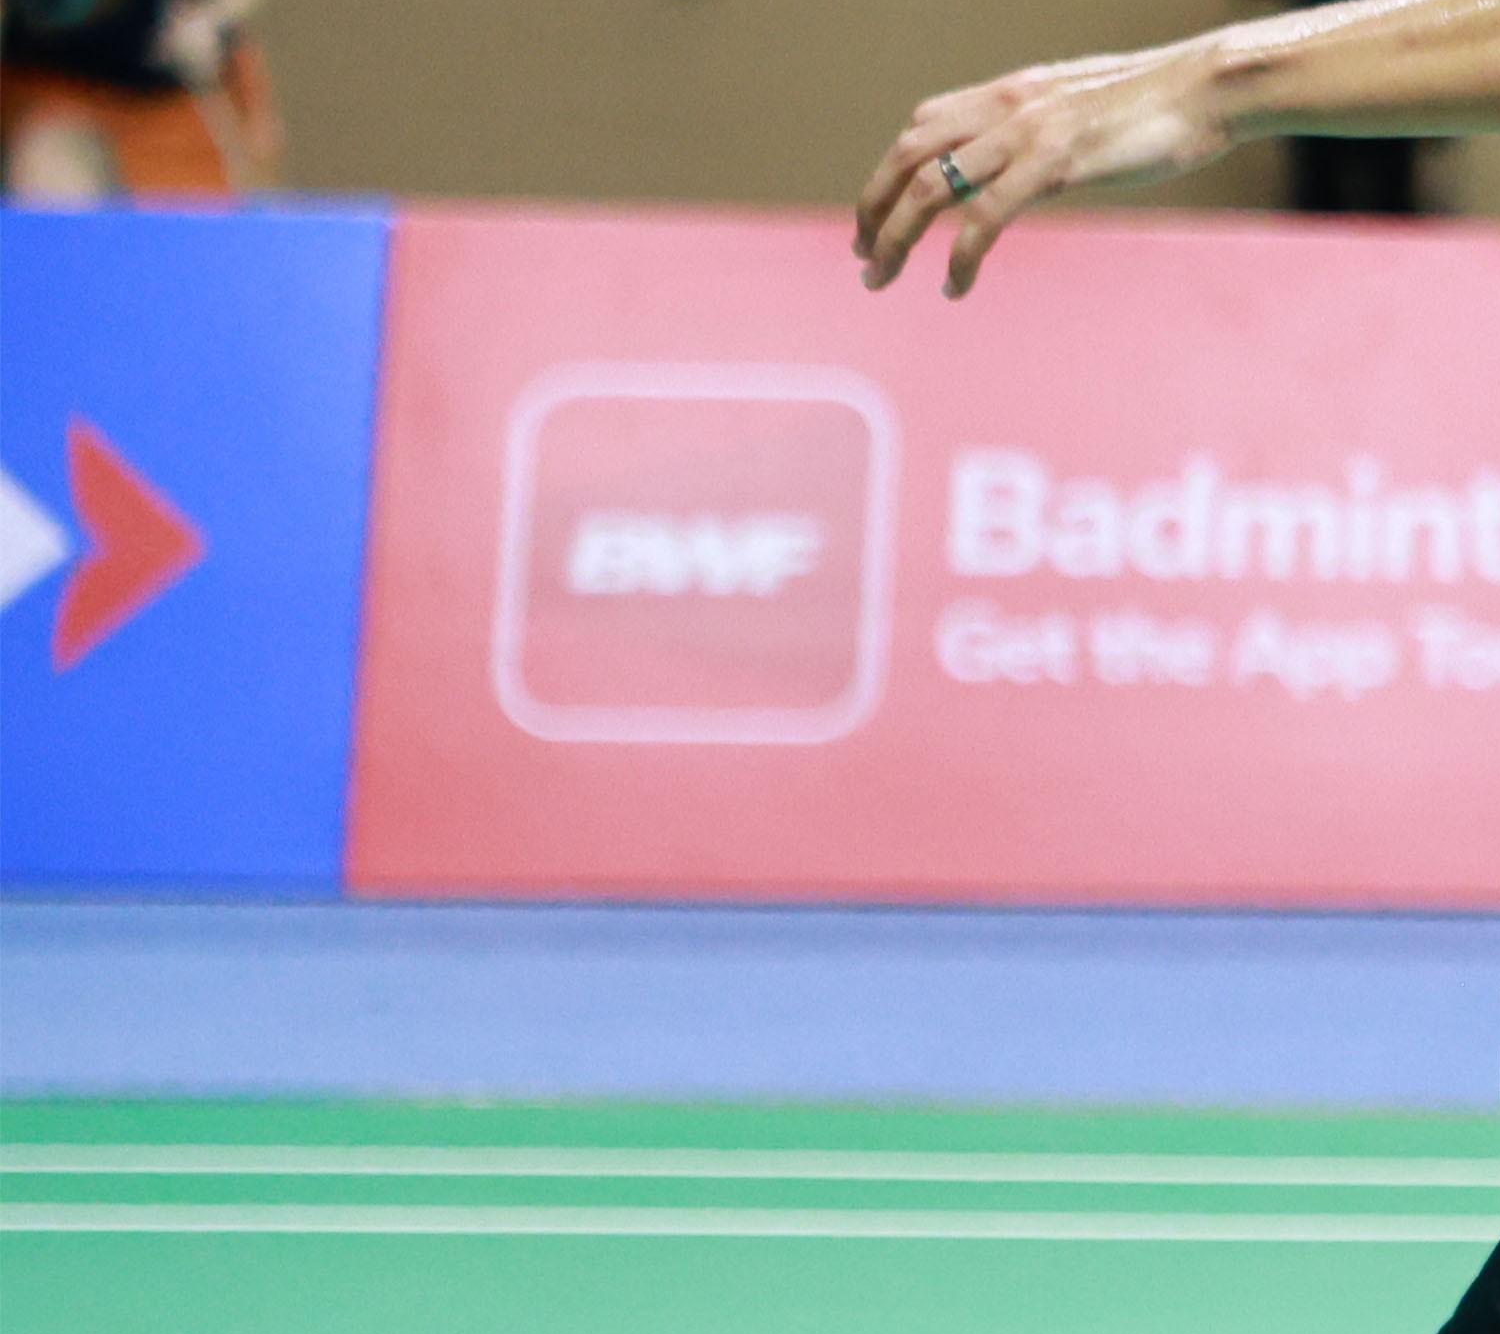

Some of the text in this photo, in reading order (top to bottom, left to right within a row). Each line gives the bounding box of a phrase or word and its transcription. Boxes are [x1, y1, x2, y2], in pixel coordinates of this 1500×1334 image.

[938, 605, 1075, 682] Get
[1094, 611, 1214, 684] the
[1233, 609, 1394, 699] App
